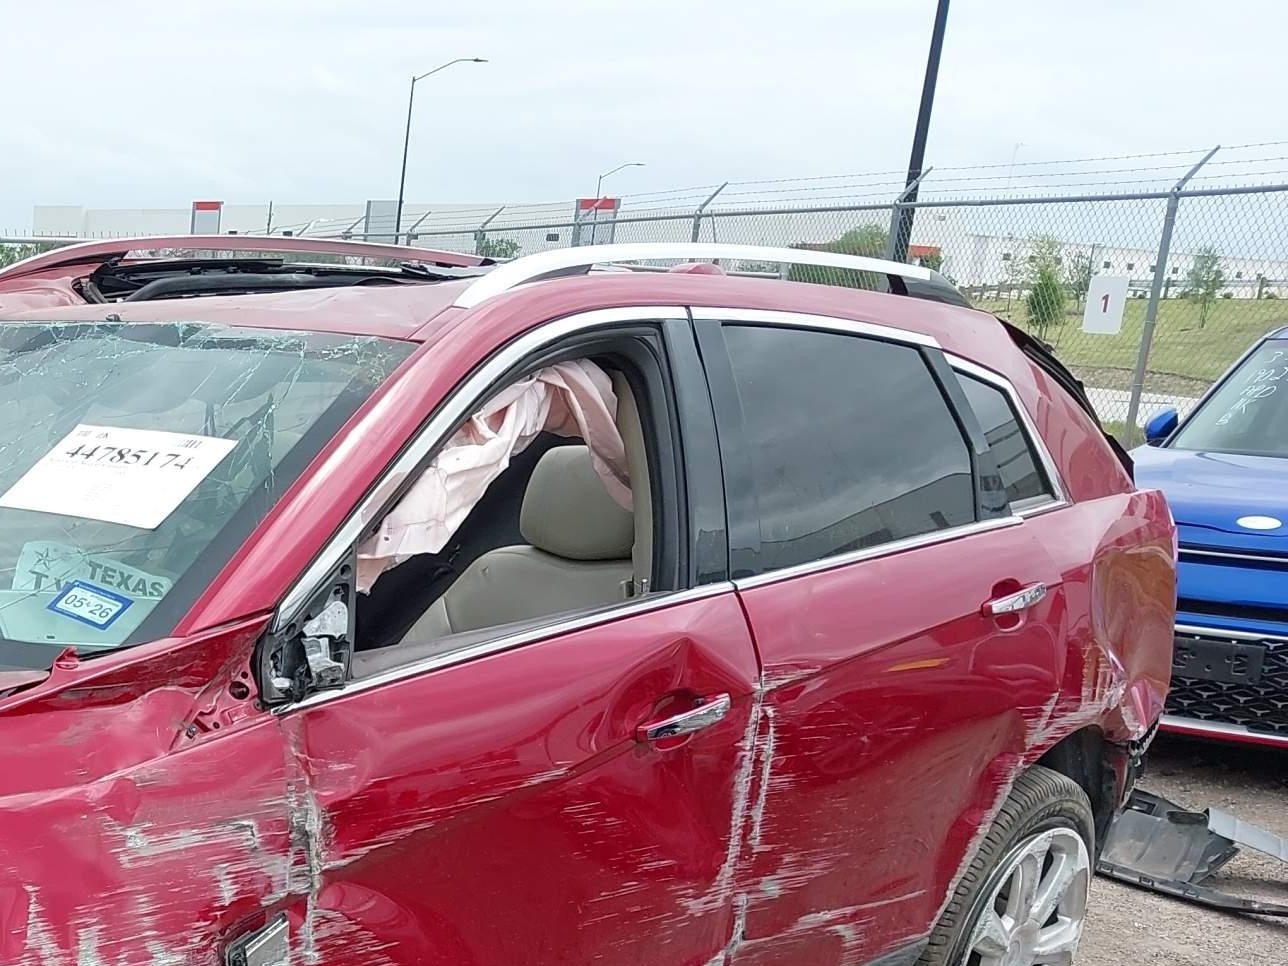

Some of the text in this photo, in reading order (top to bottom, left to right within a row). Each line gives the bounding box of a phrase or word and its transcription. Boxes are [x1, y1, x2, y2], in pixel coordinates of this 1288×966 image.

[1102, 294, 1110, 313] 1
[66, 443, 196, 470] 44785174
[87, 560, 164, 597] TEXAS
[64, 594, 113, 618] 05 26
